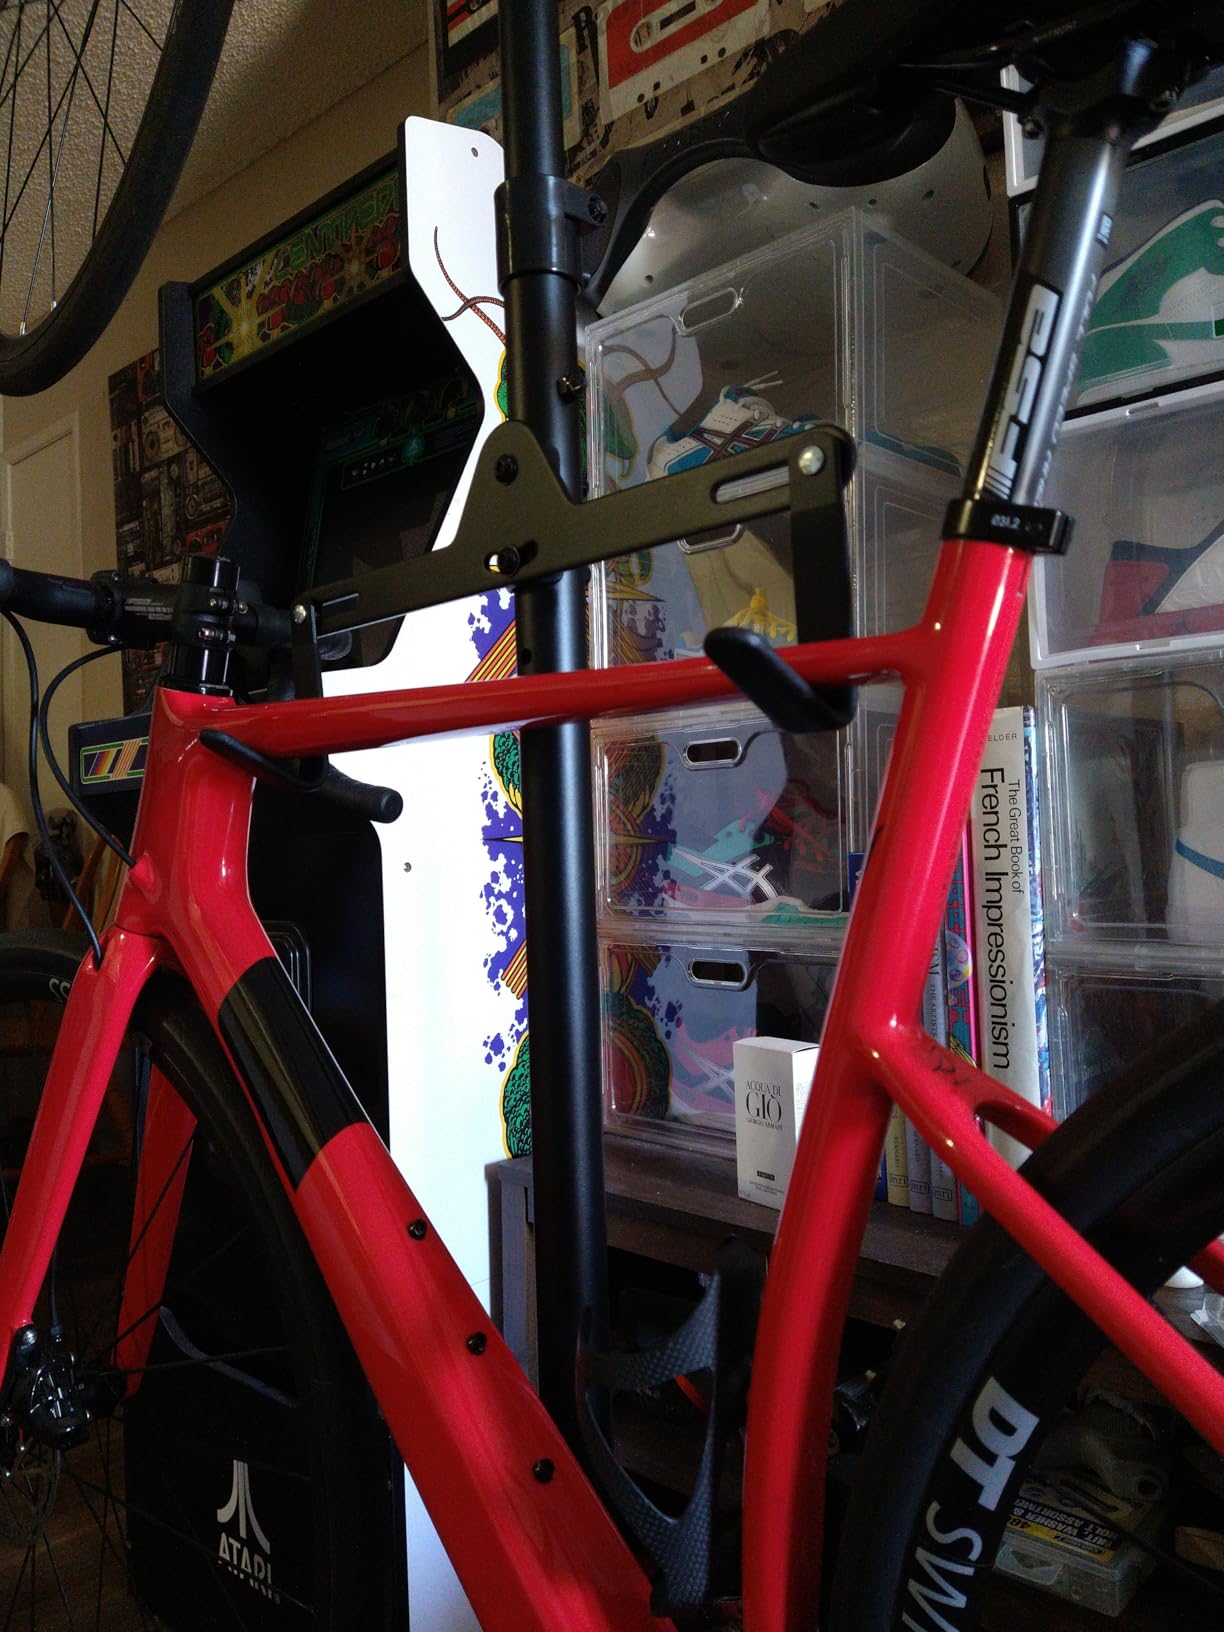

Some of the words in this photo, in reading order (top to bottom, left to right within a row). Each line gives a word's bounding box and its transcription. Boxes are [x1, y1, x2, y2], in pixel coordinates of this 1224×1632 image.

[1009, 779, 1021, 805] The
[981, 767, 1008, 860] French
[1009, 808, 1022, 842] Great
[1010, 846, 1023, 880] Book
[1011, 882, 1024, 894] of
[982, 872, 1015, 1069] Impressionism
[746, 1081, 771, 1094] ACQUA
[773, 1084, 781, 1096] DI
[746, 1091, 782, 1123] GIÒ
[950, 1376, 1040, 1512] DT
[1027, 1511, 1078, 1537] WASHER
[218, 1531, 272, 1584] ATARI
